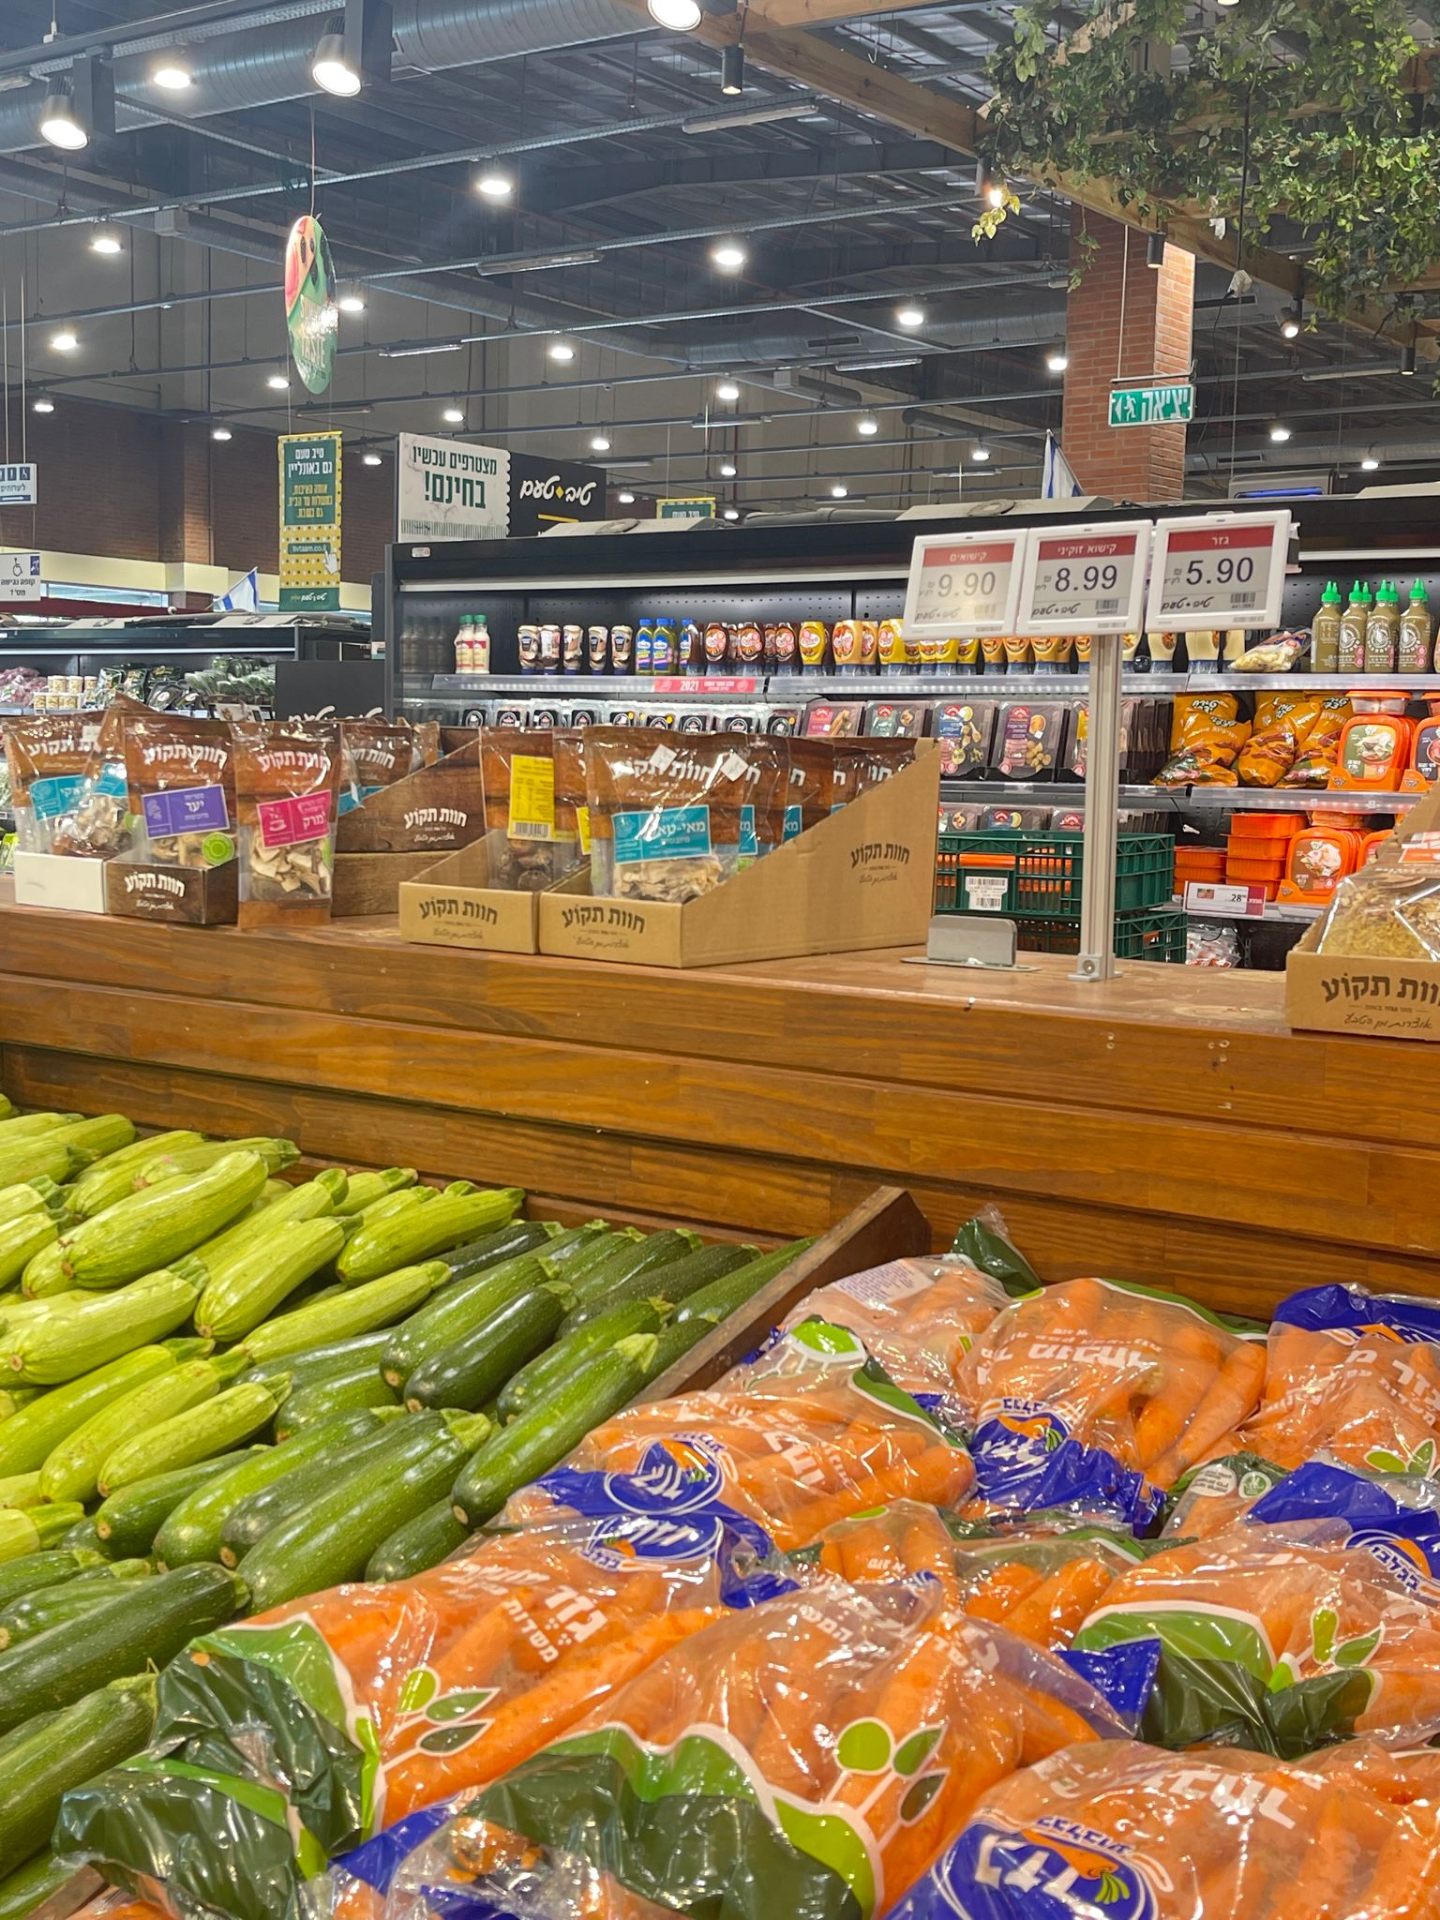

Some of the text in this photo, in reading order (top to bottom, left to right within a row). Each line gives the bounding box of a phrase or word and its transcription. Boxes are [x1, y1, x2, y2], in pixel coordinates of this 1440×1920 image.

[1141, 388, 1188, 421] יציאה
[288, 461, 332, 478] גם באונליין
[412, 445, 497, 475] מצטרפים עכשיו
[424, 470, 486, 509] בחינם!
[520, 475, 597, 506] טיב טעם
[1057, 543, 1117, 557] קישוא זוקיני
[1211, 536, 1229, 545] גזר
[949, 551, 987, 562] קישואים
[938, 571, 995, 597] 9.90
[1055, 564, 1117, 592] 8.99
[1186, 557, 1254, 585] 5.90
[680, 680, 699, 691] 2021
[404, 807, 468, 829] חוות תקוע
[850, 842, 910, 868] חוות תקוע
[124, 871, 185, 898] חוות תקוע
[419, 896, 498, 926] חוות תקוע
[562, 903, 645, 934] חוות תקוע
[1321, 972, 1440, 1006] וות תקוע
[1369, 1544, 1422, 1592] בגלבו
[545, 1585, 608, 1643] גזר
[501, 1599, 560, 1664] משדות
